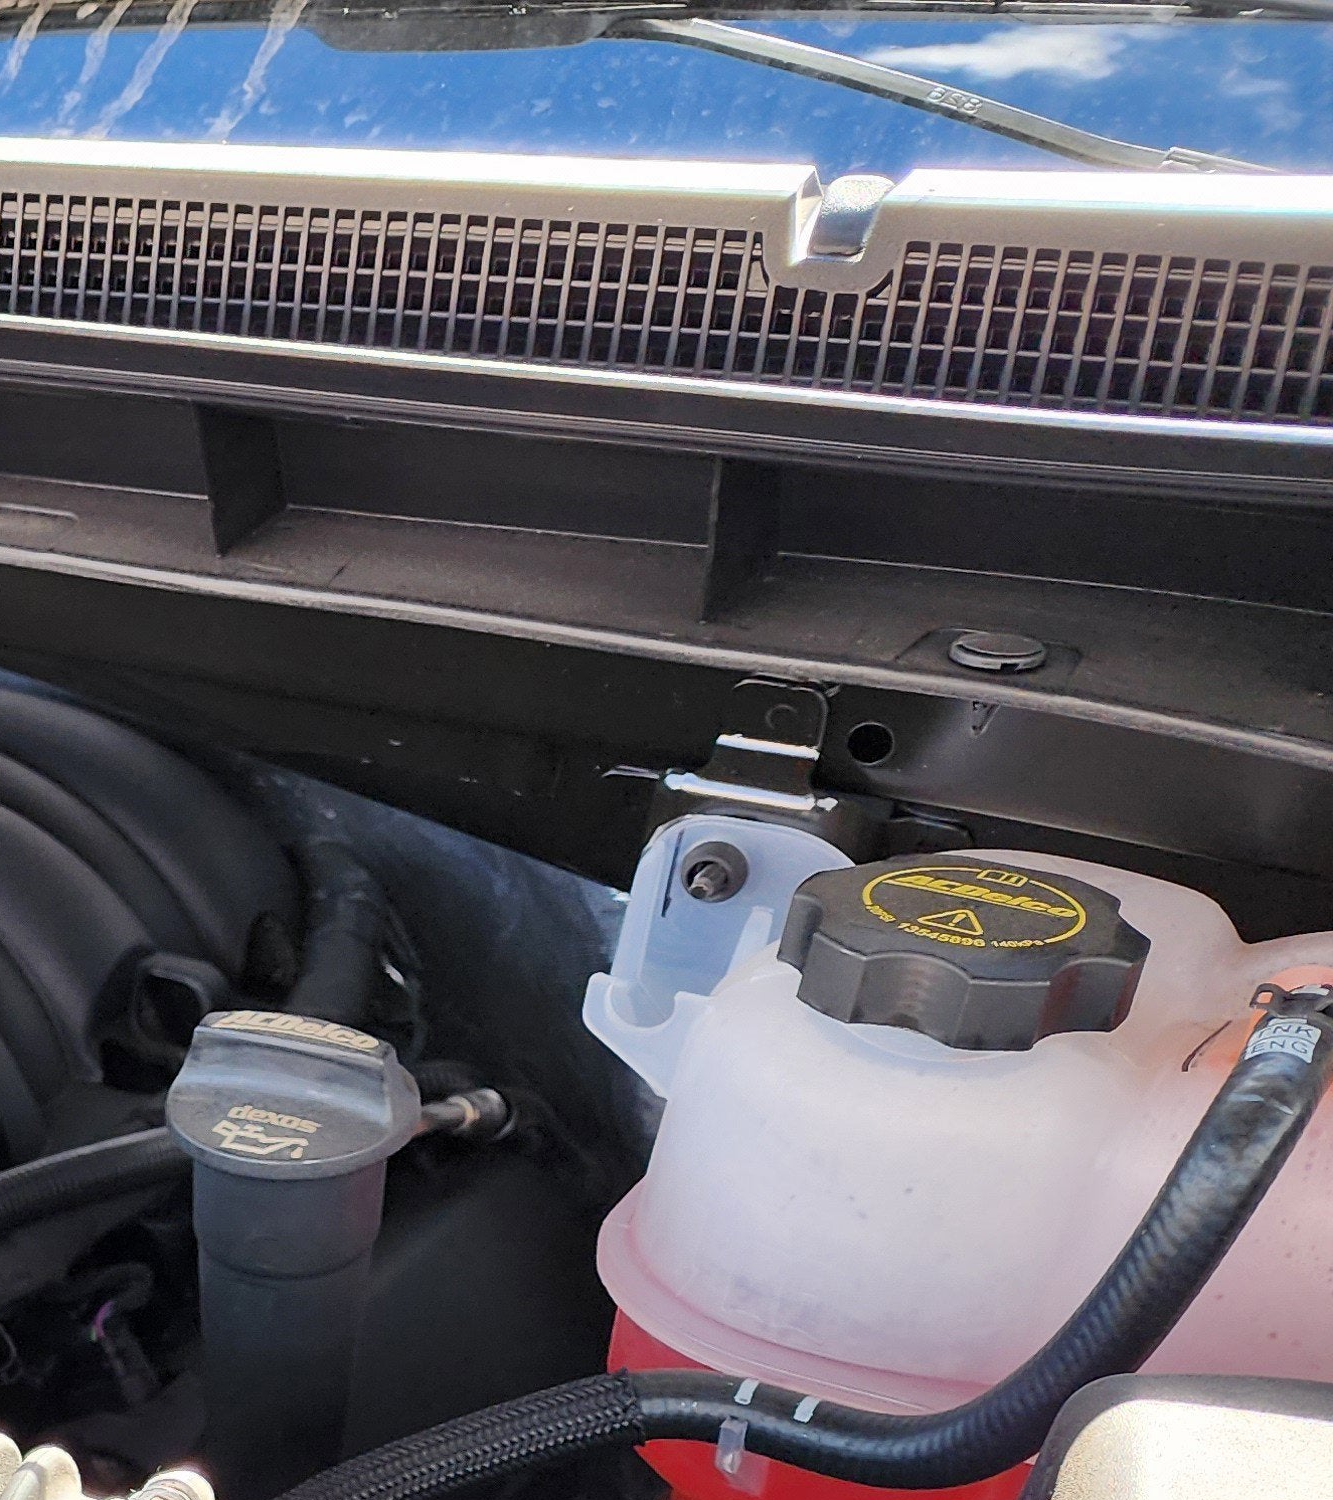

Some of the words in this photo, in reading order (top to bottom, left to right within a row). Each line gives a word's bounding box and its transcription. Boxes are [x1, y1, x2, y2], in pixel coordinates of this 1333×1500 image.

[883, 873, 1079, 919] ACDelco
[213, 1010, 380, 1051] ACDelco
[1252, 1040, 1308, 1058] ENG
[227, 1105, 322, 1134] dexos
